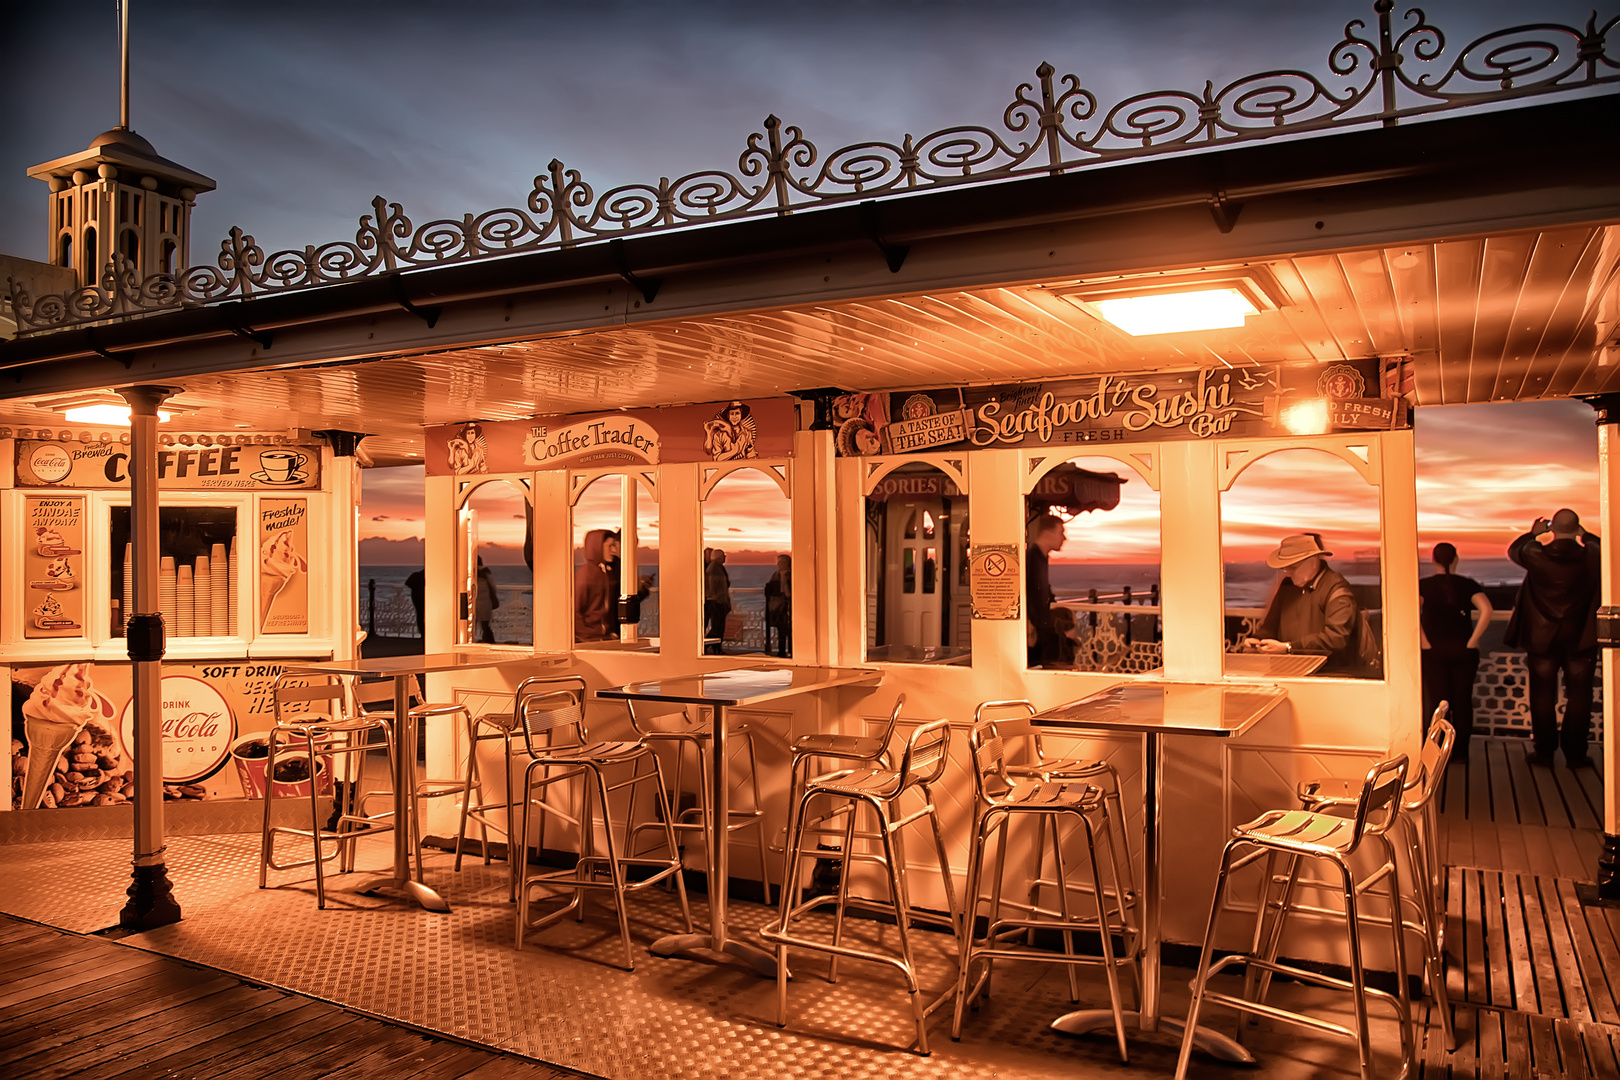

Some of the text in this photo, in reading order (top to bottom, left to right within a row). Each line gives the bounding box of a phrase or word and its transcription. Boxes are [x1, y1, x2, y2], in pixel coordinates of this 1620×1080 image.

[1000, 382, 1043, 402] Brighton's
[970, 368, 1234, 446] Seafood & Sushi
[1013, 393, 1040, 412] finest
[1344, 402, 1393, 420] FRESH
[531, 426, 548, 438] THE
[899, 413, 956, 435] A TASTE OF
[1188, 411, 1238, 438] Bar
[531, 421, 655, 462] Coffee Trader
[897, 425, 962, 450] THE SEA!
[1064, 429, 1124, 442] FRESH
[72, 446, 114, 460] Brewed
[579, 455, 592, 463] MORE
[593, 453, 605, 461] THAN
[617, 452, 636, 463] COFFEE
[105, 447, 242, 483] CFFEE
[201, 480, 256, 488] SERVED HERE
[32, 508, 81, 517] SUNDAE
[262, 503, 305, 521] Freshly
[32, 518, 77, 526] ANYDAY!
[265, 515, 300, 531] made!
[202, 665, 283, 678] SOFT DRIN
[163, 700, 191, 709] DRINK
[161, 711, 223, 739] a-Cola
[176, 745, 218, 754] COLD
